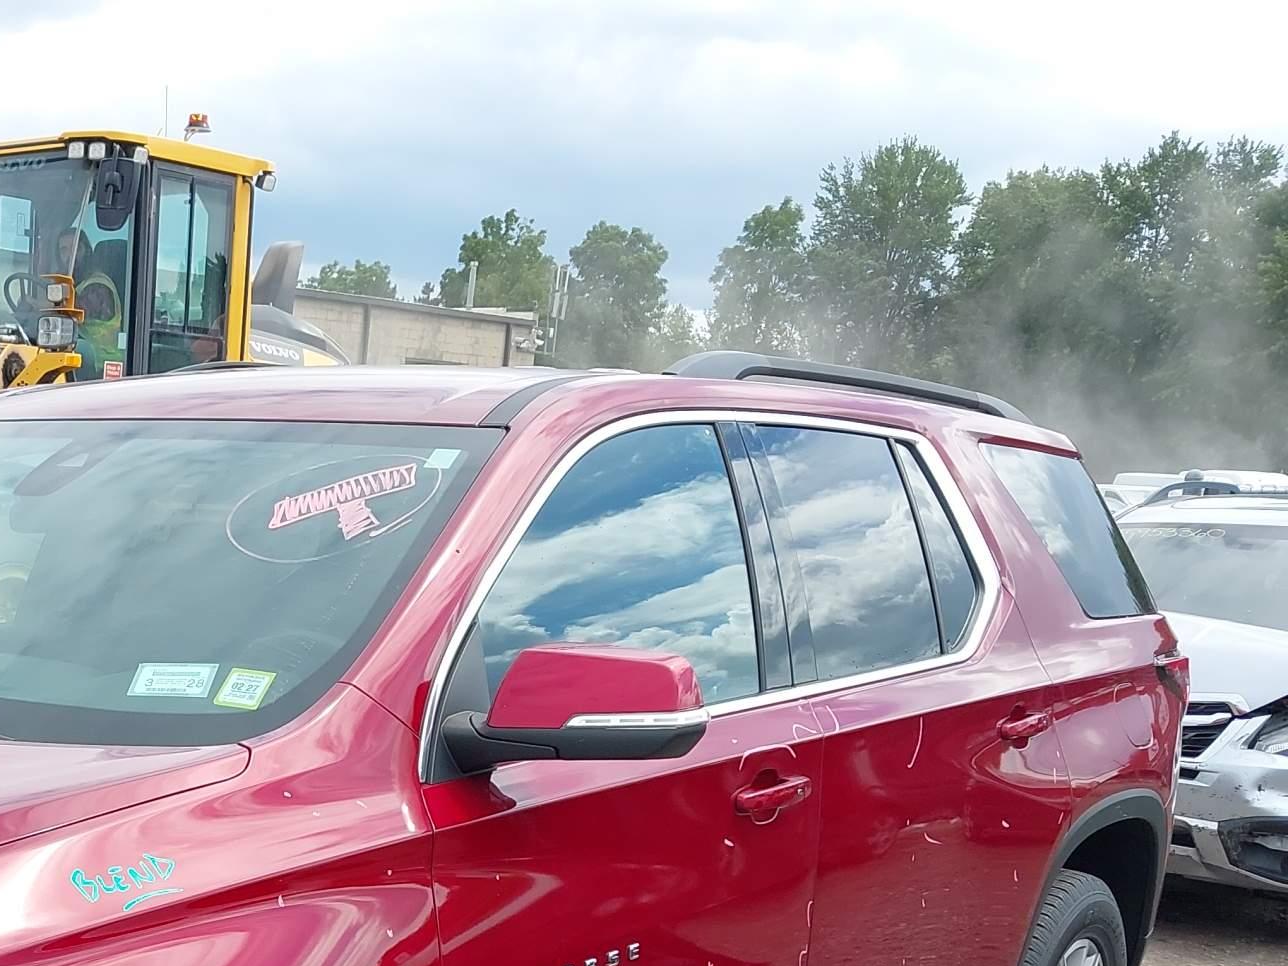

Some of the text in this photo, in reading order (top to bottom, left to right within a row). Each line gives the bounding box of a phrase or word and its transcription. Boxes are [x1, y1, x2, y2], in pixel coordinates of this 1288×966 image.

[250, 341, 300, 361] VOLVO
[231, 682, 260, 692] 02 27
[71, 853, 175, 903] BLEND
